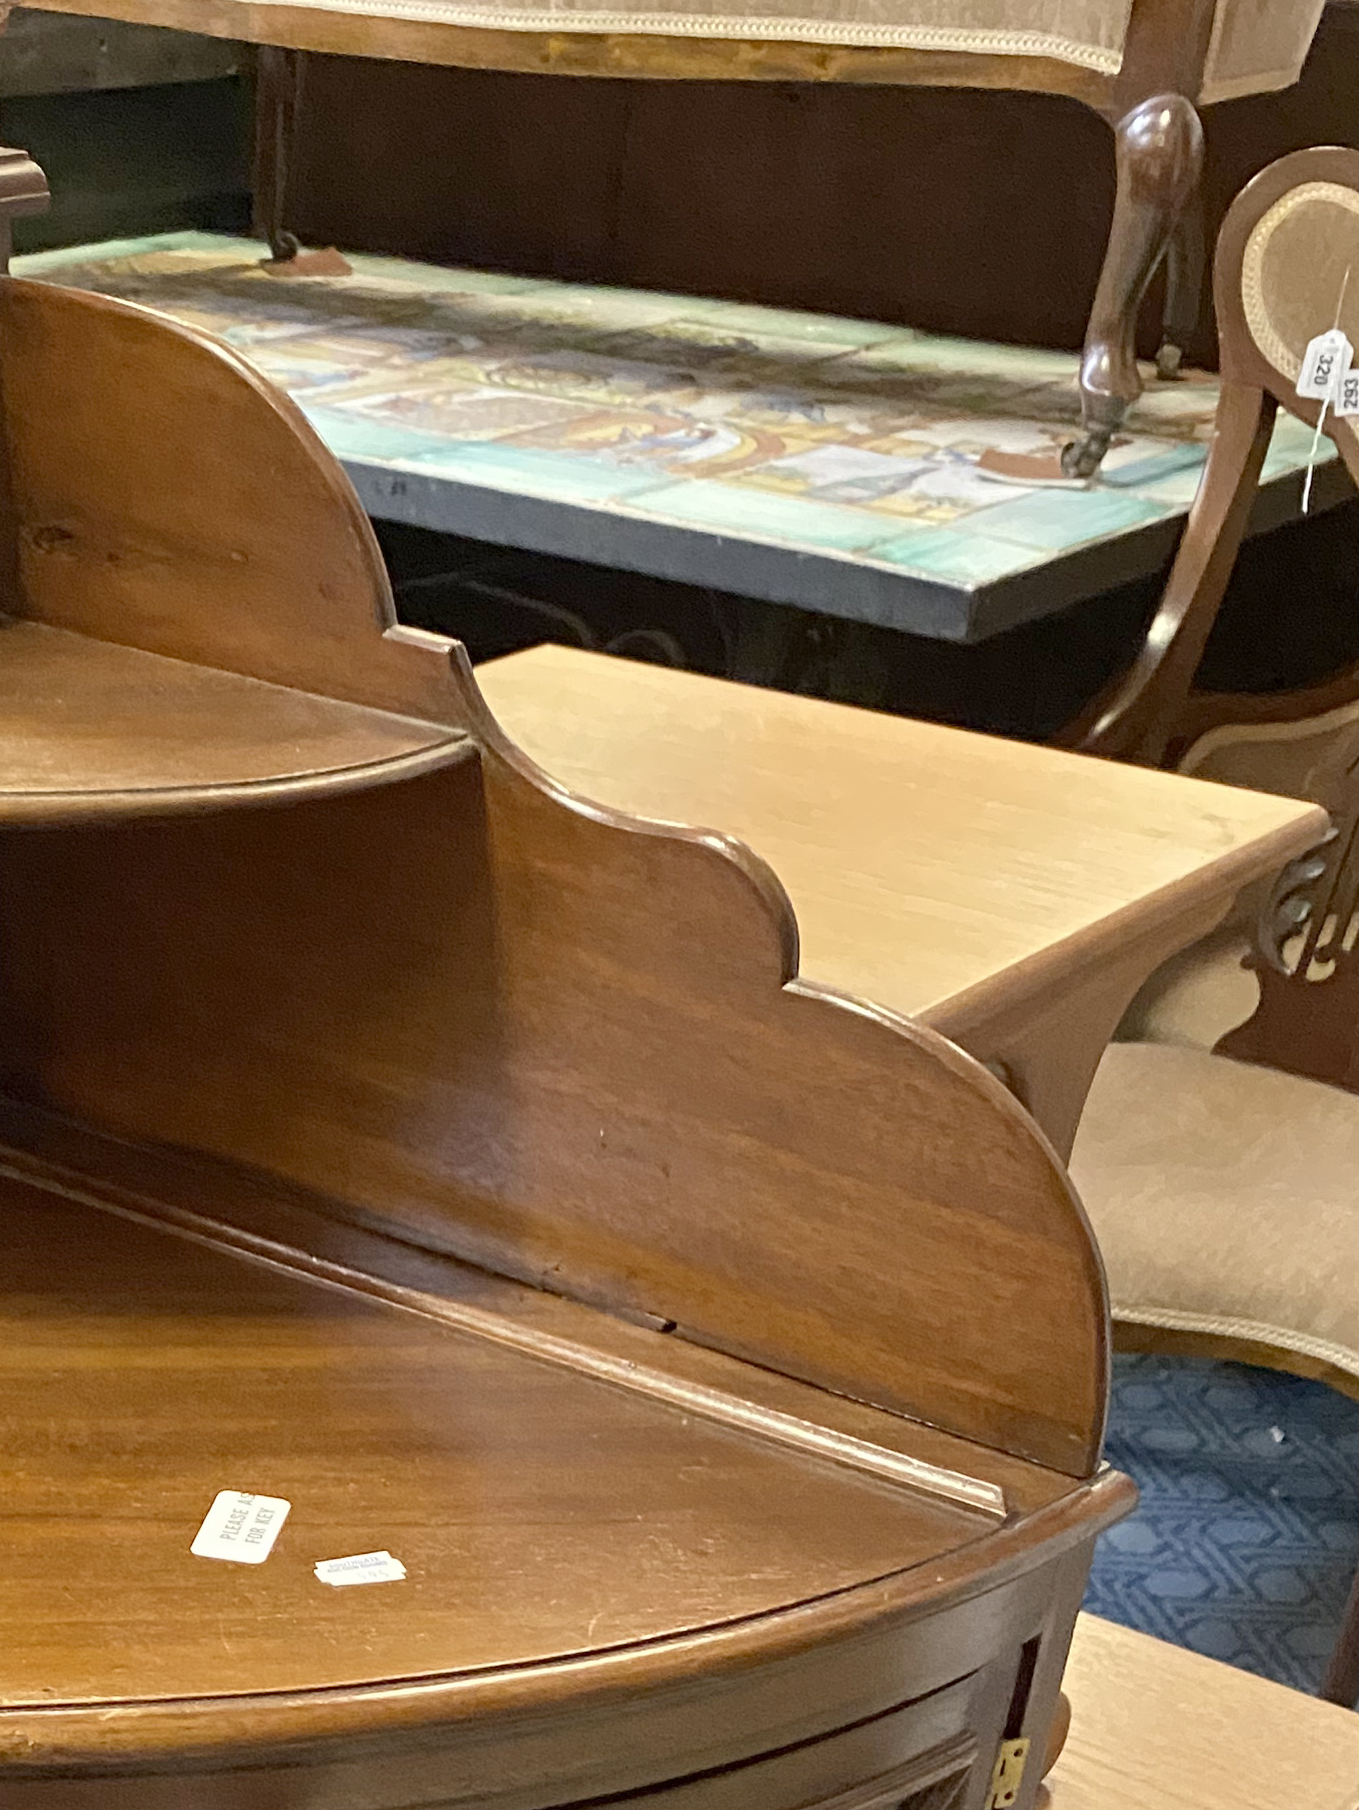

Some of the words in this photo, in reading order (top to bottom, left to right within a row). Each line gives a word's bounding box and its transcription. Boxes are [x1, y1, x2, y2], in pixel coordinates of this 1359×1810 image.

[1314, 355, 1333, 385] 320
[1344, 378, 1358, 408] 293
[219, 1508, 250, 1541] PLEASE
[254, 1507, 276, 1525] KEY
[245, 1527, 267, 1545] FOR
